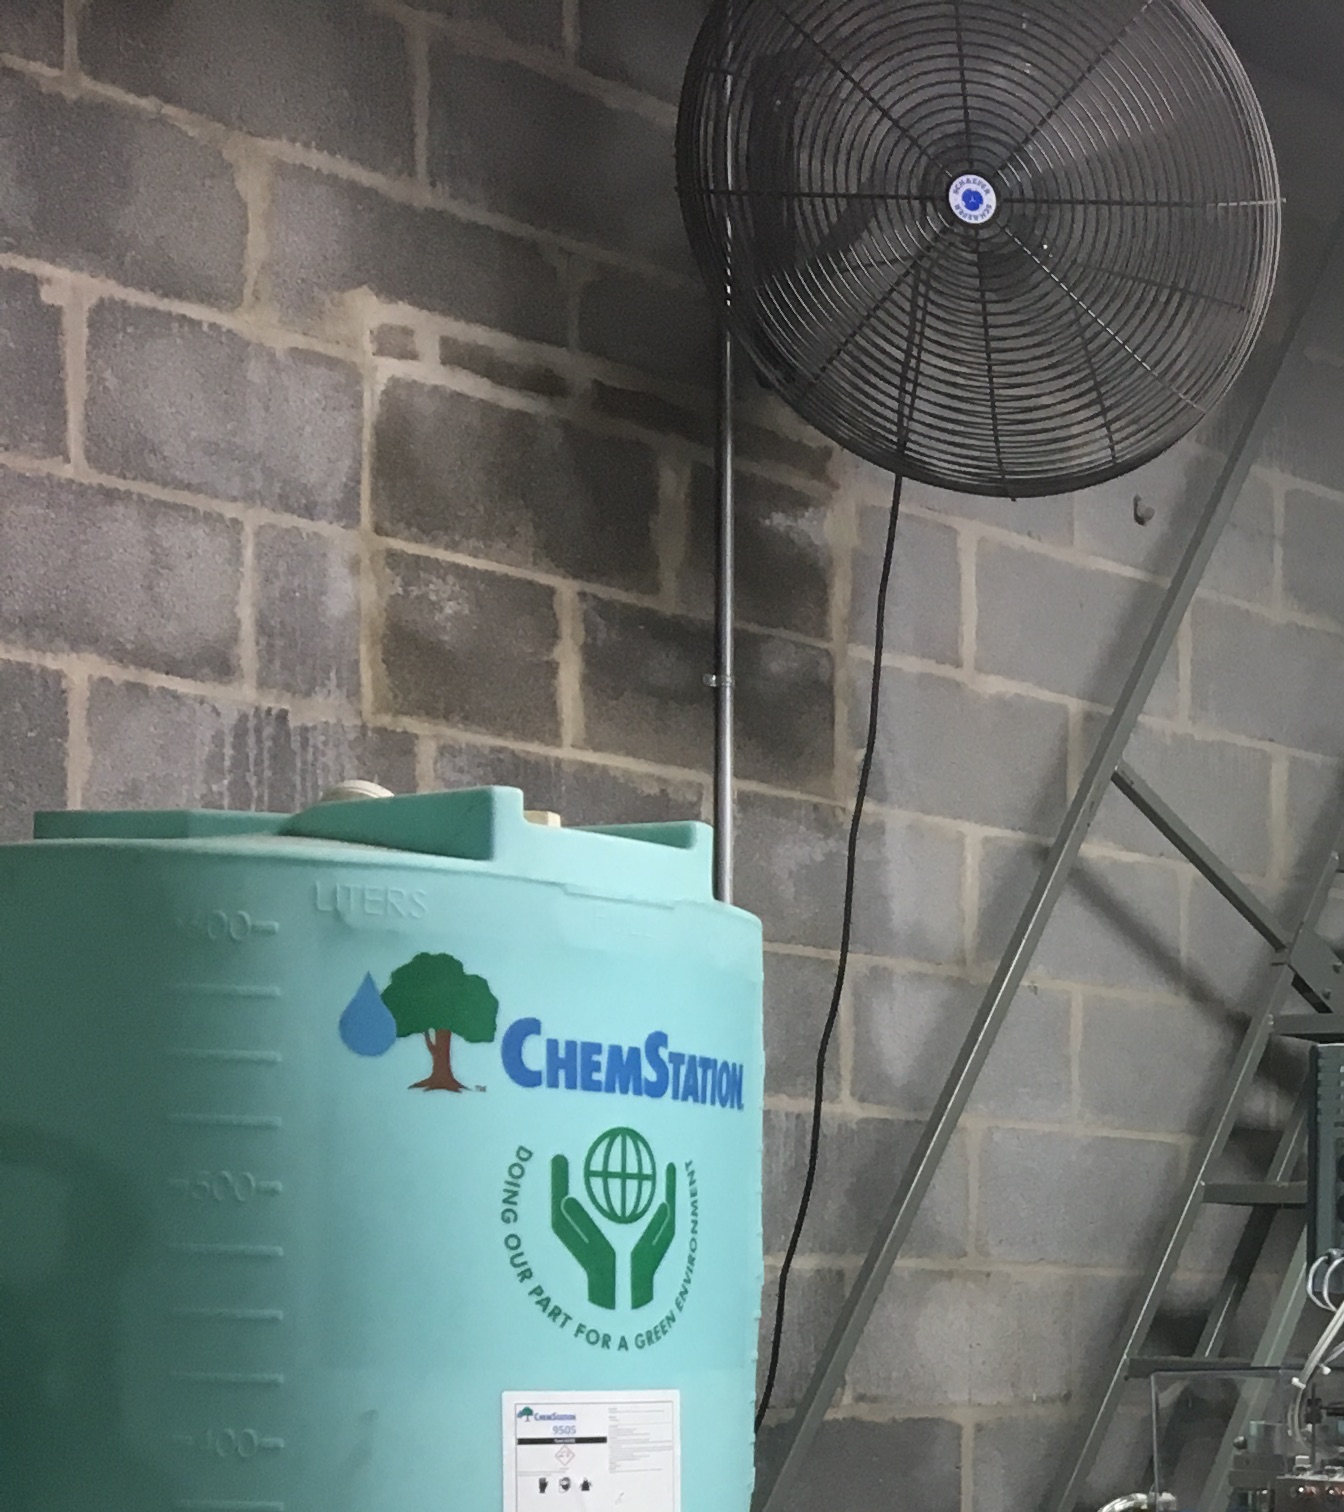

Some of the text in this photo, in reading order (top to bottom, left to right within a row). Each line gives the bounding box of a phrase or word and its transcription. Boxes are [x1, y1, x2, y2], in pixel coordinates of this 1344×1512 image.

[502, 1017, 744, 1111] CHEMSTATION
[501, 1146, 699, 1351] DOING OUR PART FOR A GREEN ENVIRONMENT
[552, 1425, 577, 1435] 9505
